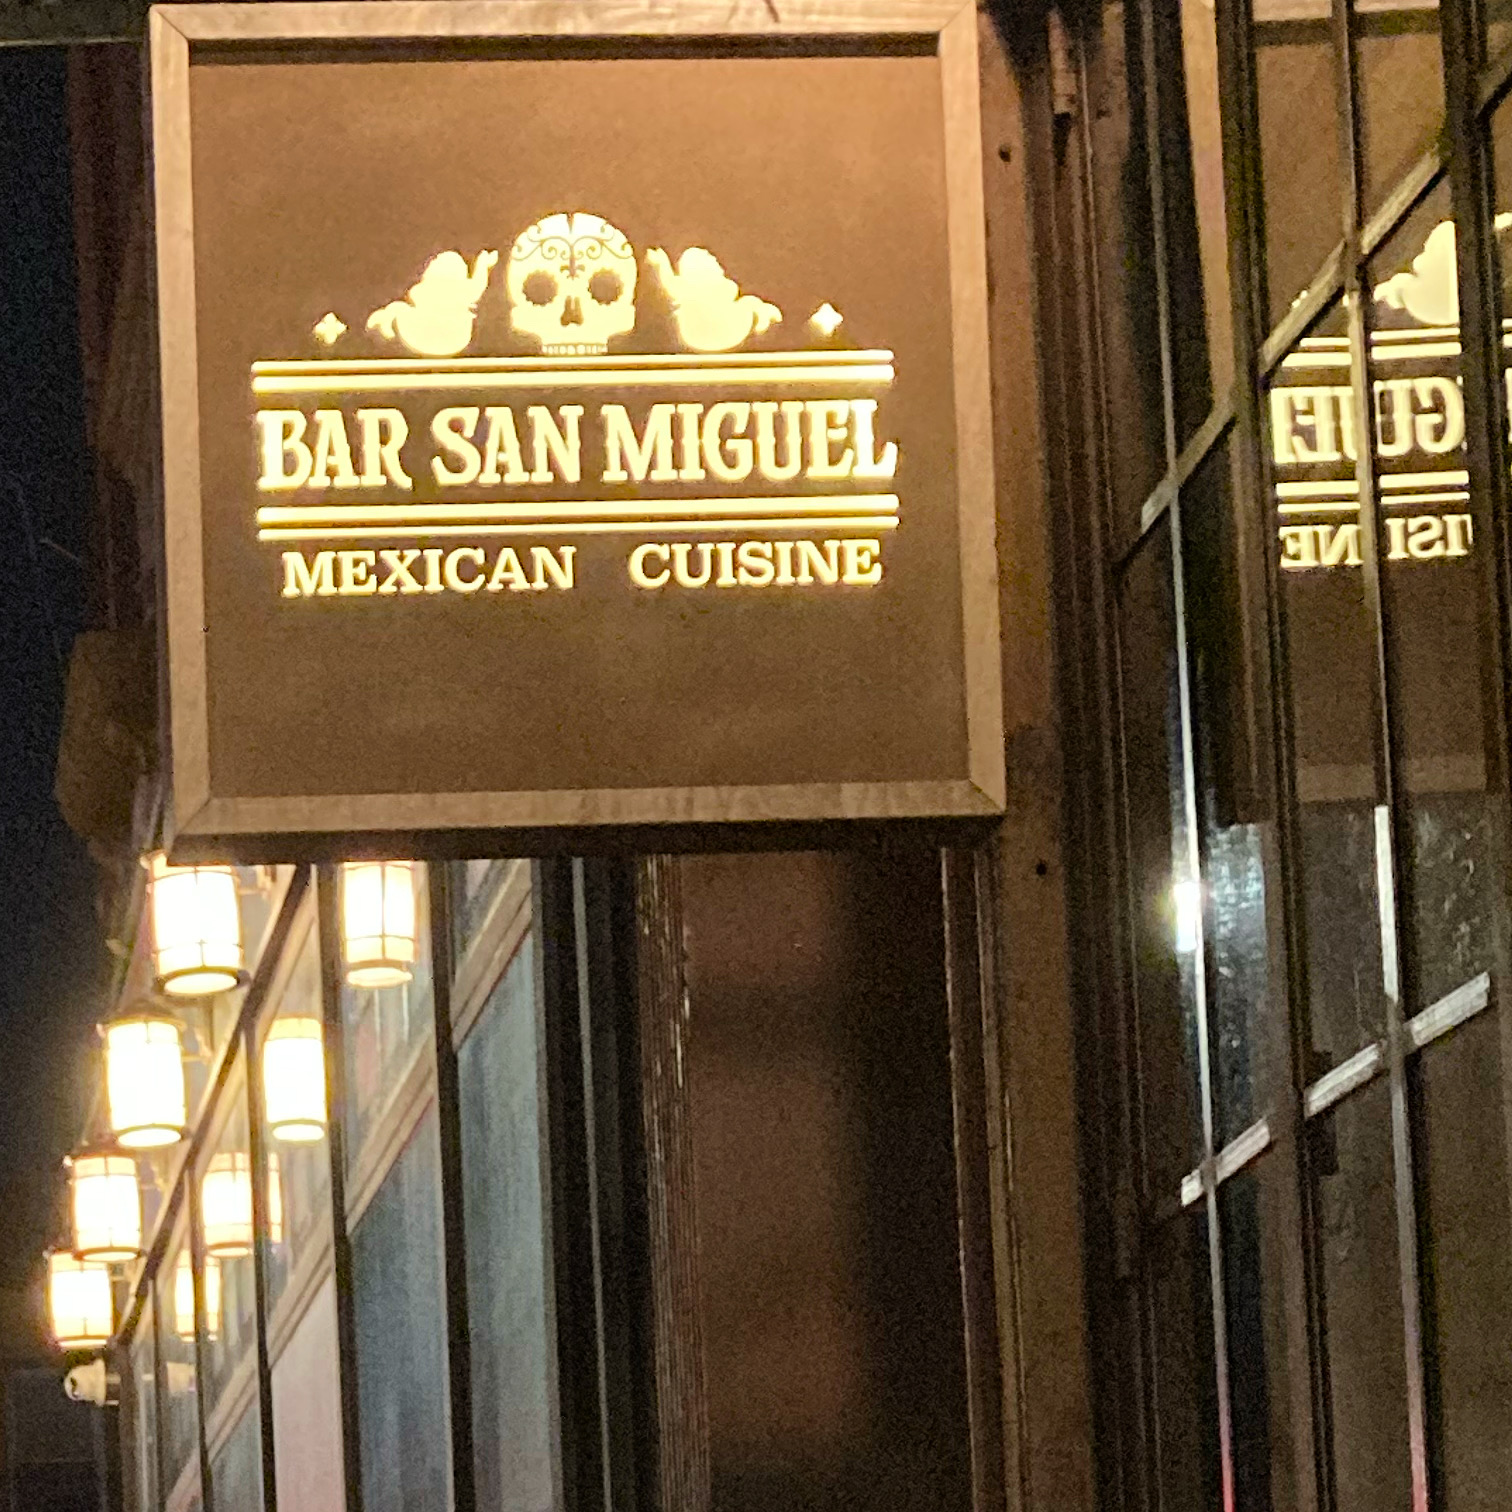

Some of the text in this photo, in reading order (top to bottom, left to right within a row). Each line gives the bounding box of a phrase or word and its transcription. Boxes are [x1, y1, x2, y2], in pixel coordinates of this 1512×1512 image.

[256, 398, 900, 492] BAR SAN MIGUEL
[280, 538, 883, 599] MEXICAN CUISINE
